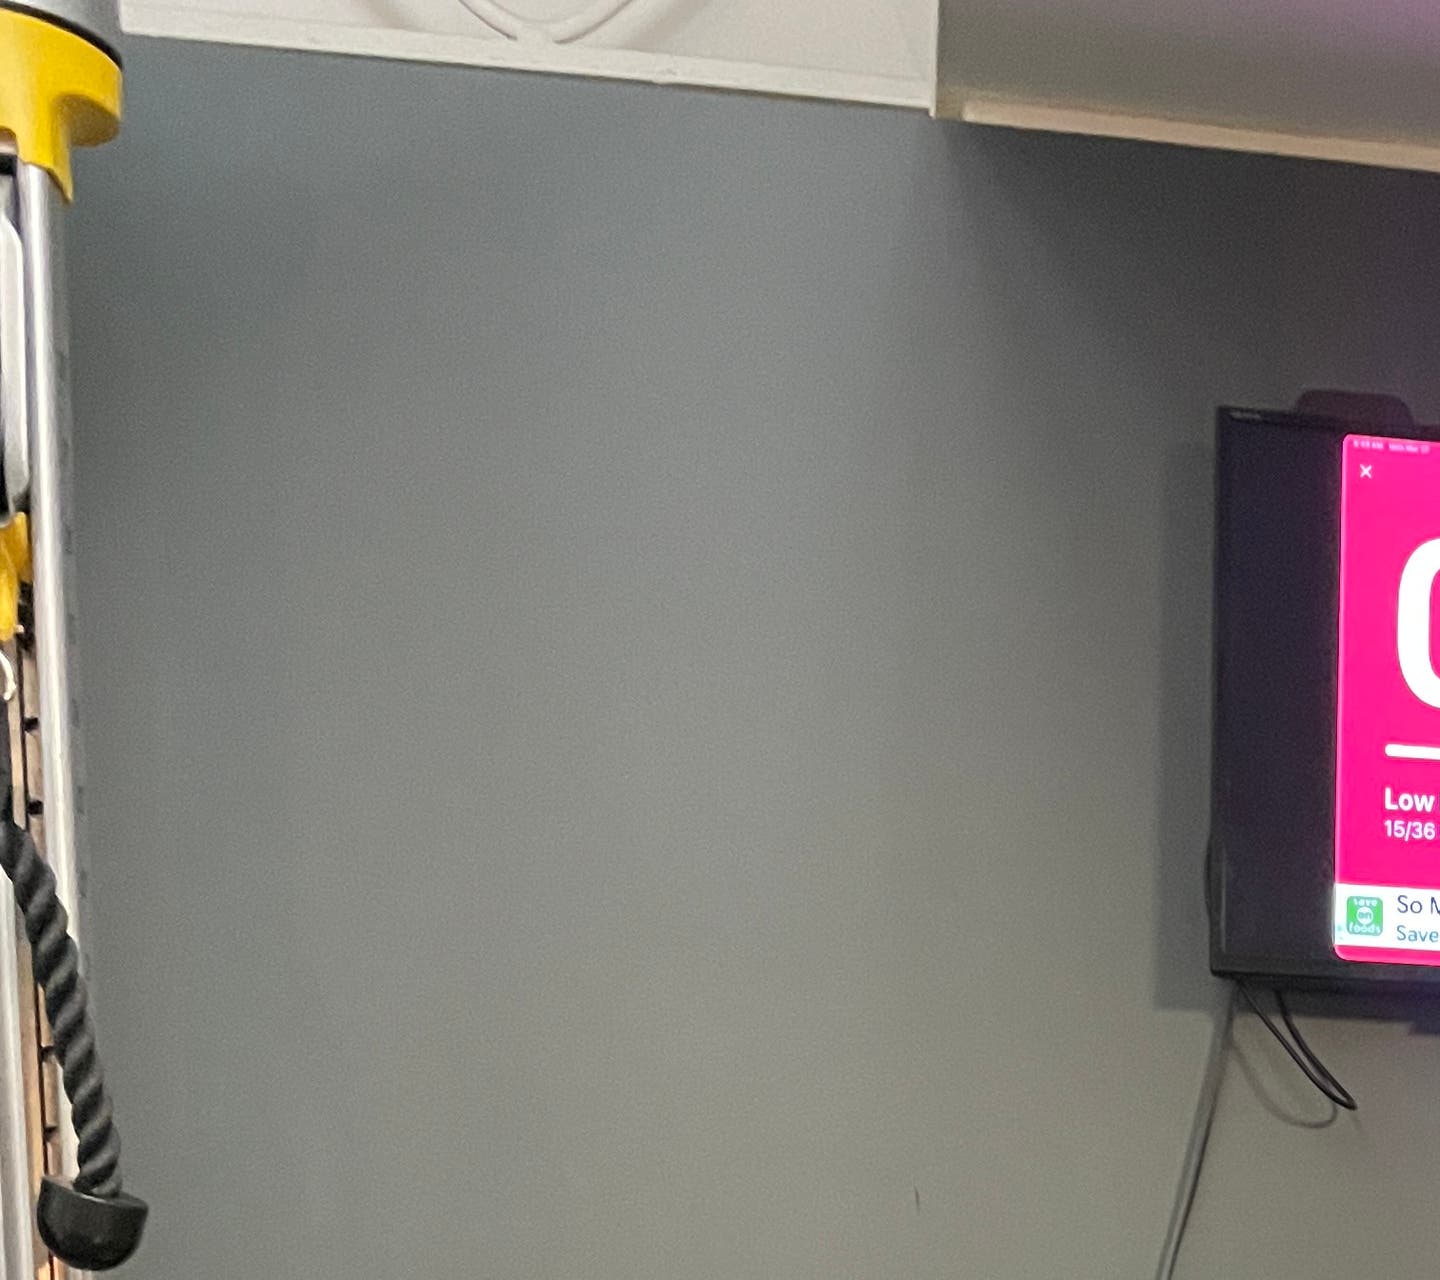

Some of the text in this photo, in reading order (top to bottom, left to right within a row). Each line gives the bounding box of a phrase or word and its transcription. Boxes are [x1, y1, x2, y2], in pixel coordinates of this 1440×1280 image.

[1384, 787, 1435, 813] Low
[1384, 820, 1436, 841] 15/36
[1397, 895, 1423, 914] So
